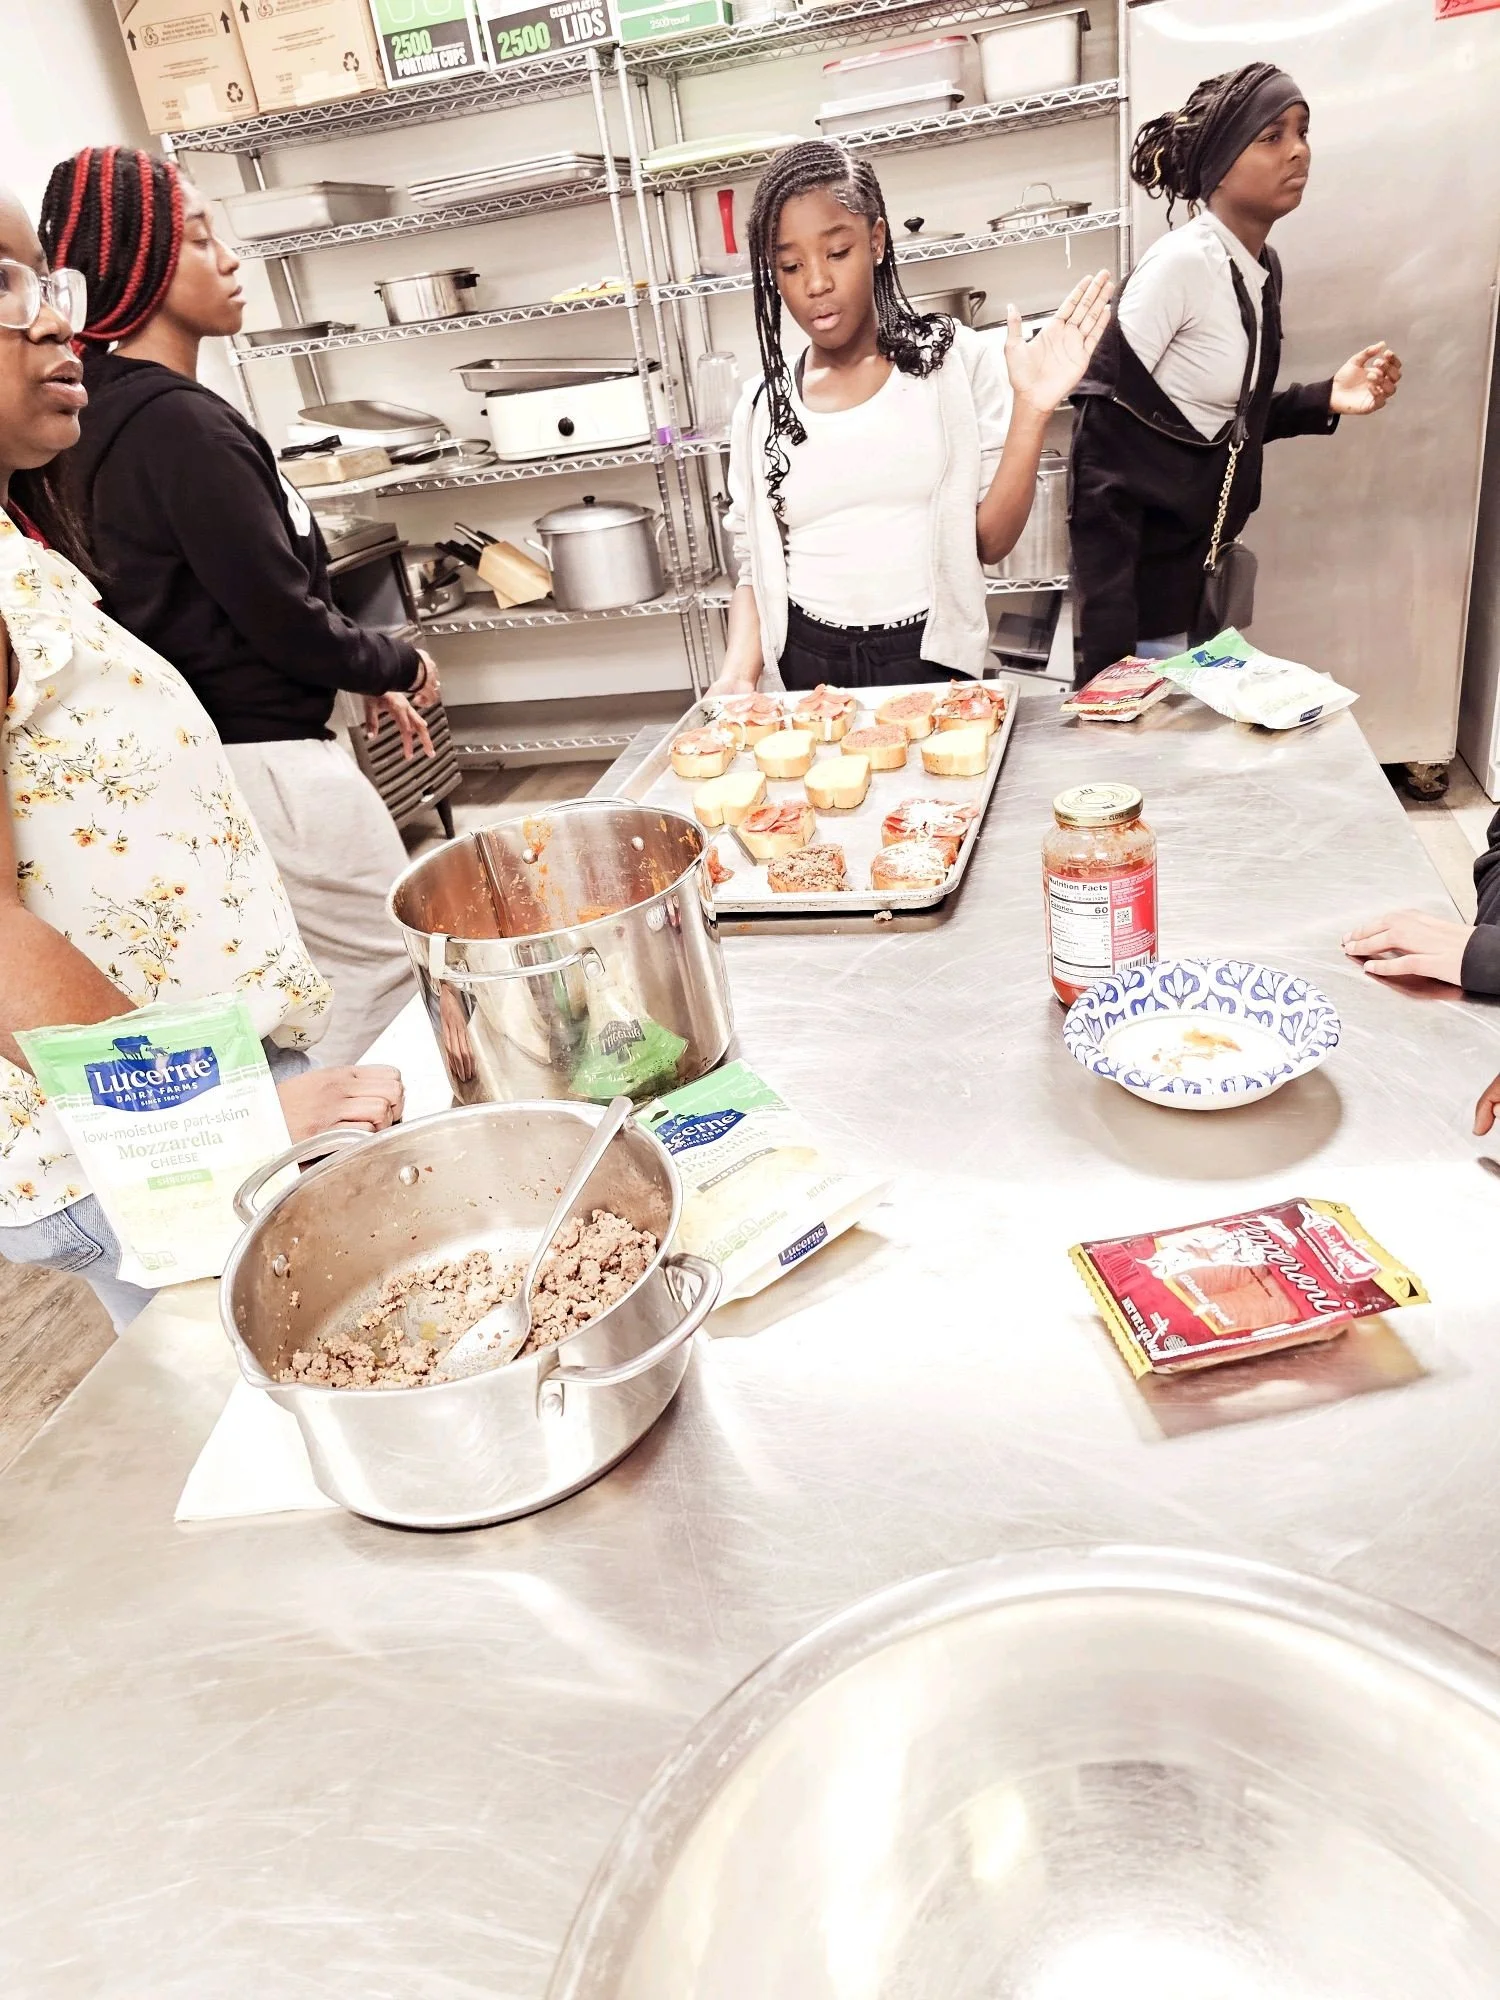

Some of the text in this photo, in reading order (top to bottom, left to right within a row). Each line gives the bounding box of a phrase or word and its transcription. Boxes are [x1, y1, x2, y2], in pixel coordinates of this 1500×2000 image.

[497, 21, 551, 60] 2500
[560, 8, 607, 44] LIDS
[391, 29, 433, 60] 2500
[396, 47, 468, 77] PORTION CUPS
[1049, 877, 1108, 892] Nutrition Facts
[1050, 900, 1109, 914] Calories 60
[93, 1058, 213, 1094] Lucerne
[116, 1082, 199, 1103] DAIRY FARMS
[140, 1097, 162, 1106] SINCE
[83, 1107, 250, 1144] low-moisture part-skim
[117, 1130, 223, 1160] Mozzarella
[151, 1152, 199, 1169] CHEESE
[781, 1227, 825, 1260] Lucerne
